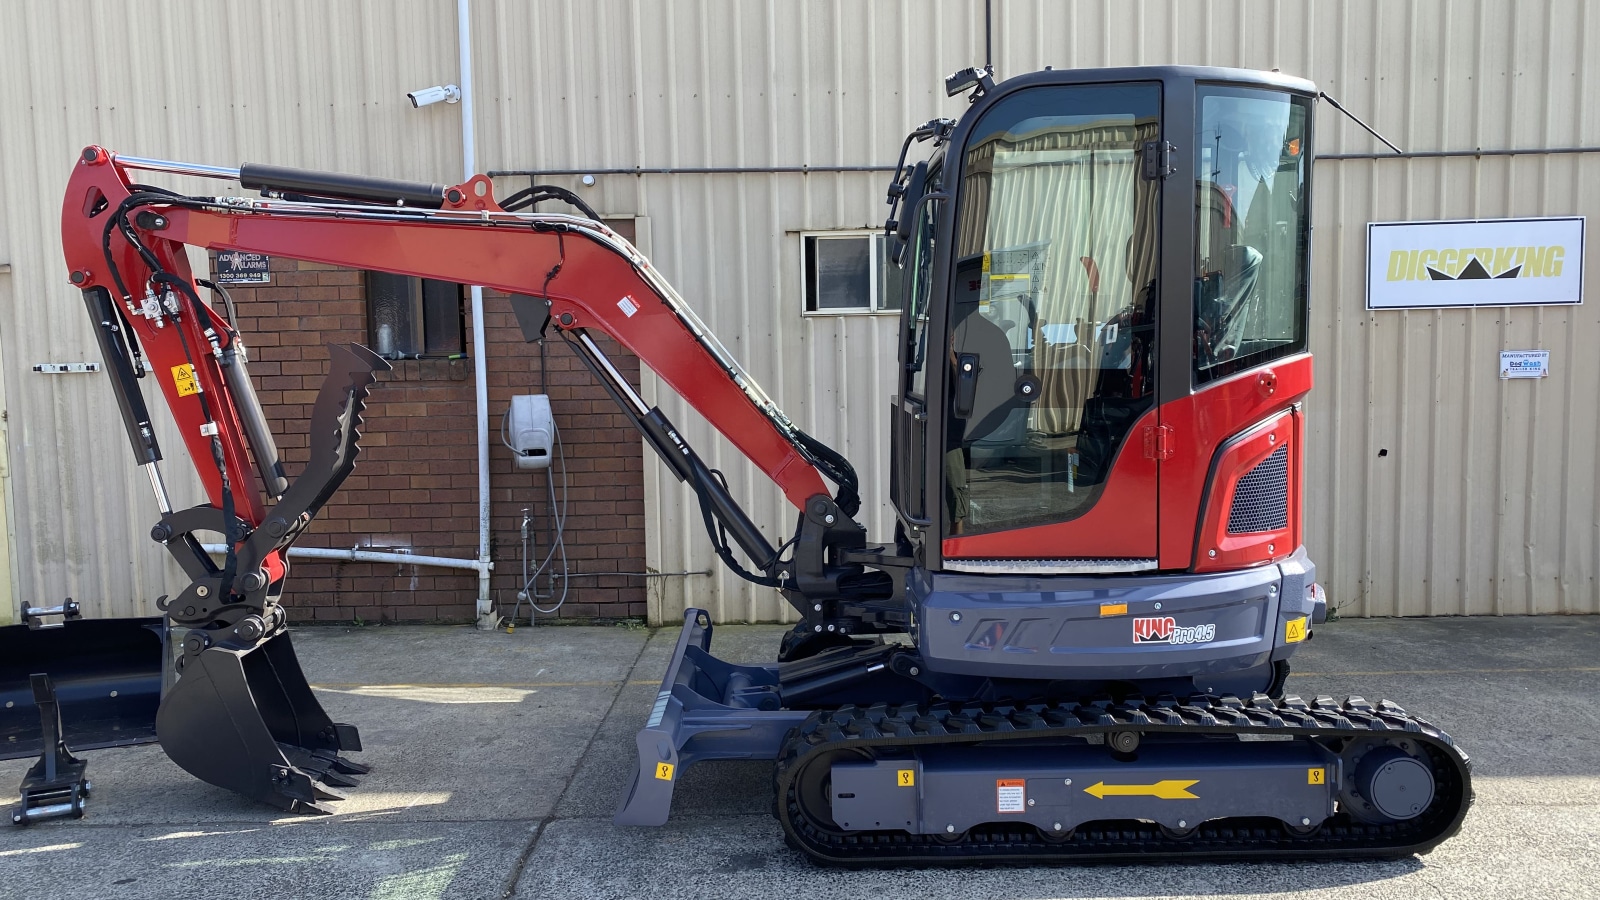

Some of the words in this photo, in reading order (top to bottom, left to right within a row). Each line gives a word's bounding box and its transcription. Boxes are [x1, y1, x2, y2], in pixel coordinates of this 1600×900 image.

[219, 253, 260, 261] ADVANCED
[1386, 246, 1565, 281] DIGGERKING
[1134, 618, 1175, 642] KING
[1171, 624, 1215, 644] Pro4.5
